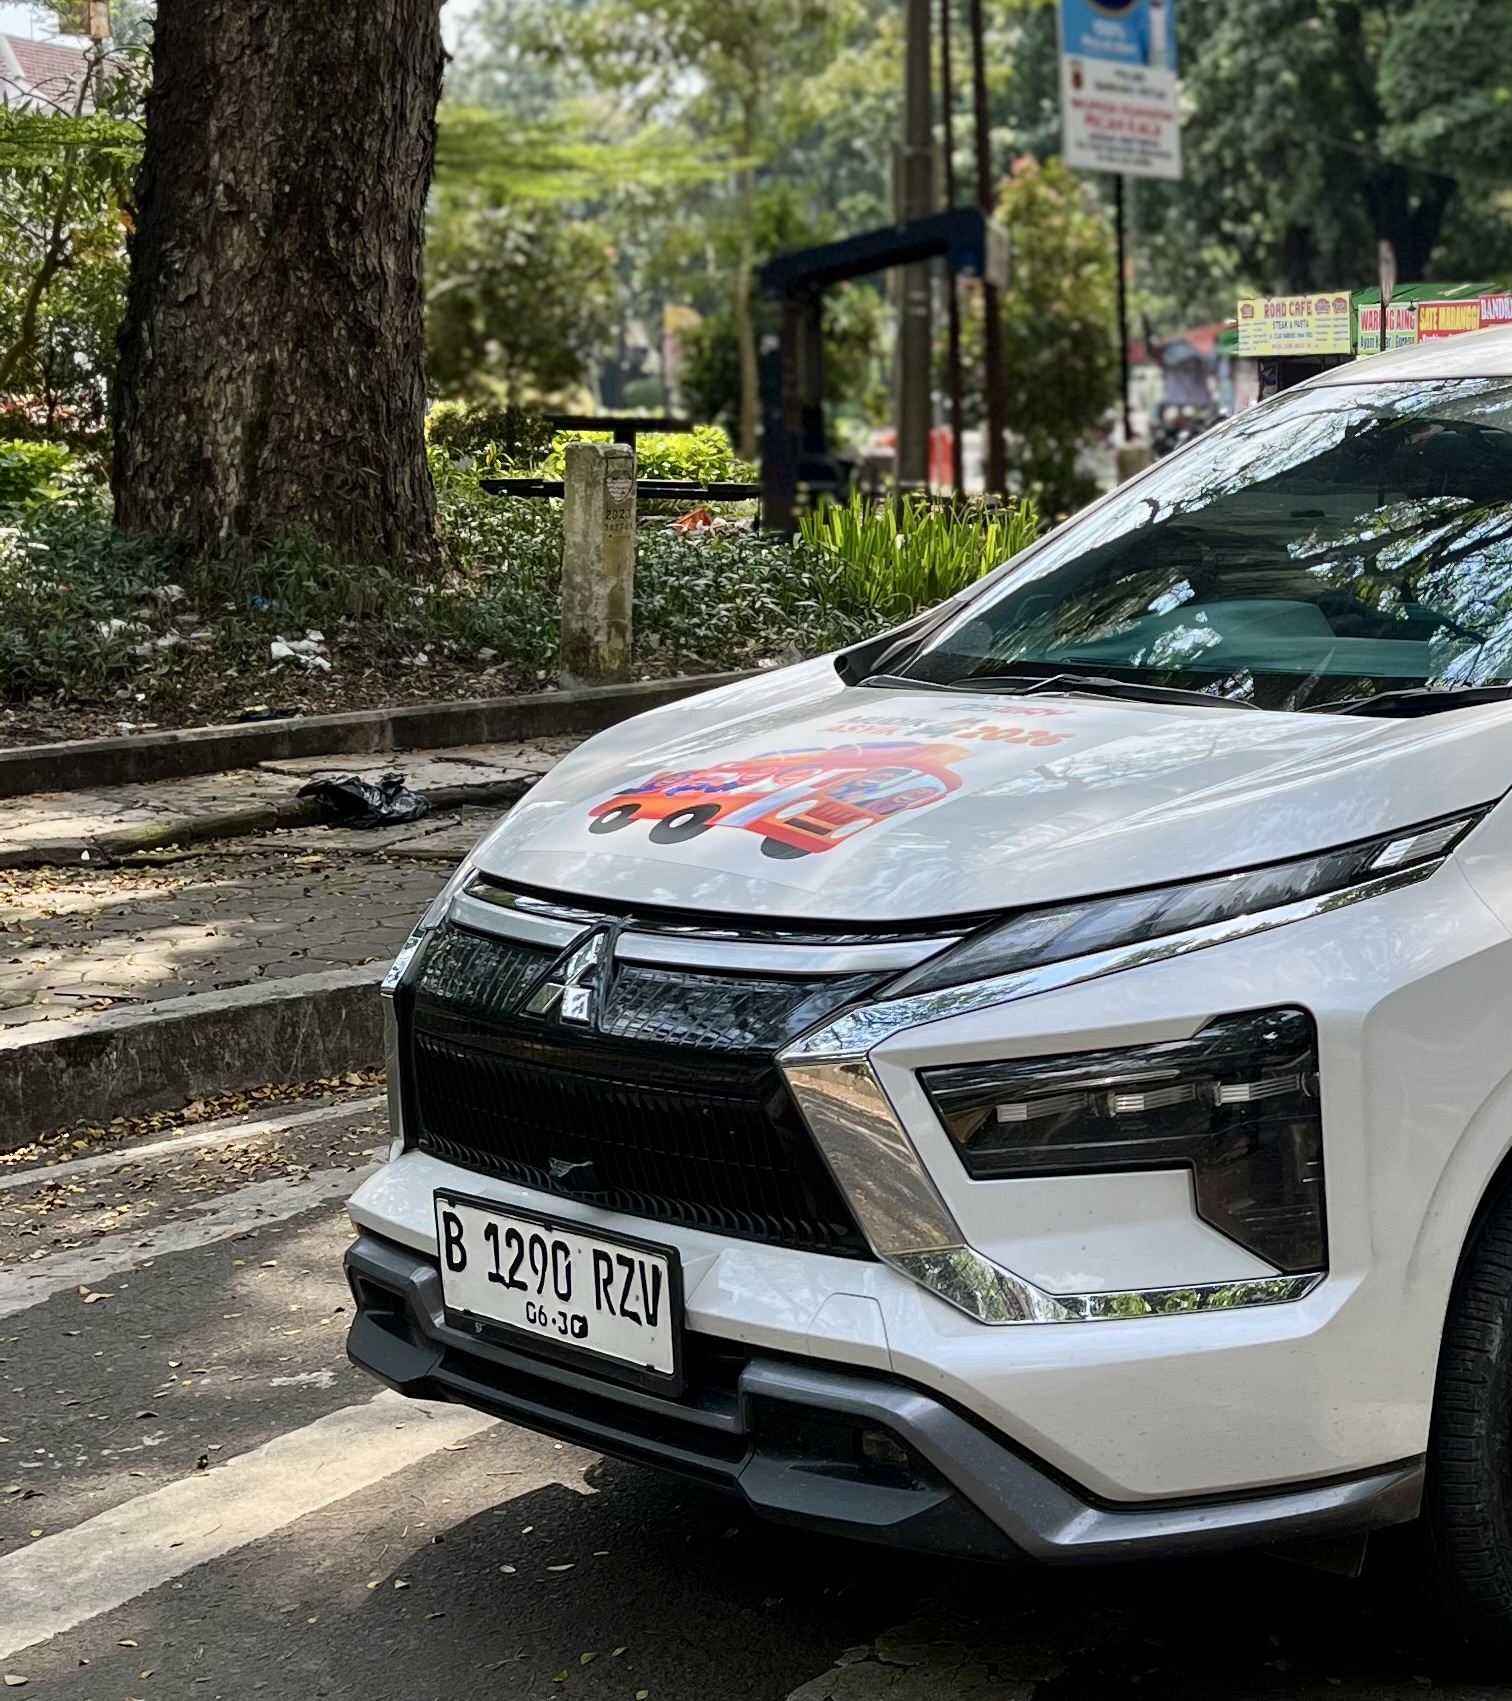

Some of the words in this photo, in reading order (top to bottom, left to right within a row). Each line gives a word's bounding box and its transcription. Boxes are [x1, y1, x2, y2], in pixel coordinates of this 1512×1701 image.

[1264, 301, 1287, 319] ROAD
[1289, 300, 1312, 317] CAFE
[1420, 306, 1438, 331] SATE
[952, 725, 1076, 747] 2026
[442, 1210, 468, 1273] B
[483, 1221, 573, 1303] 1290
[592, 1248, 663, 1327] RZV
